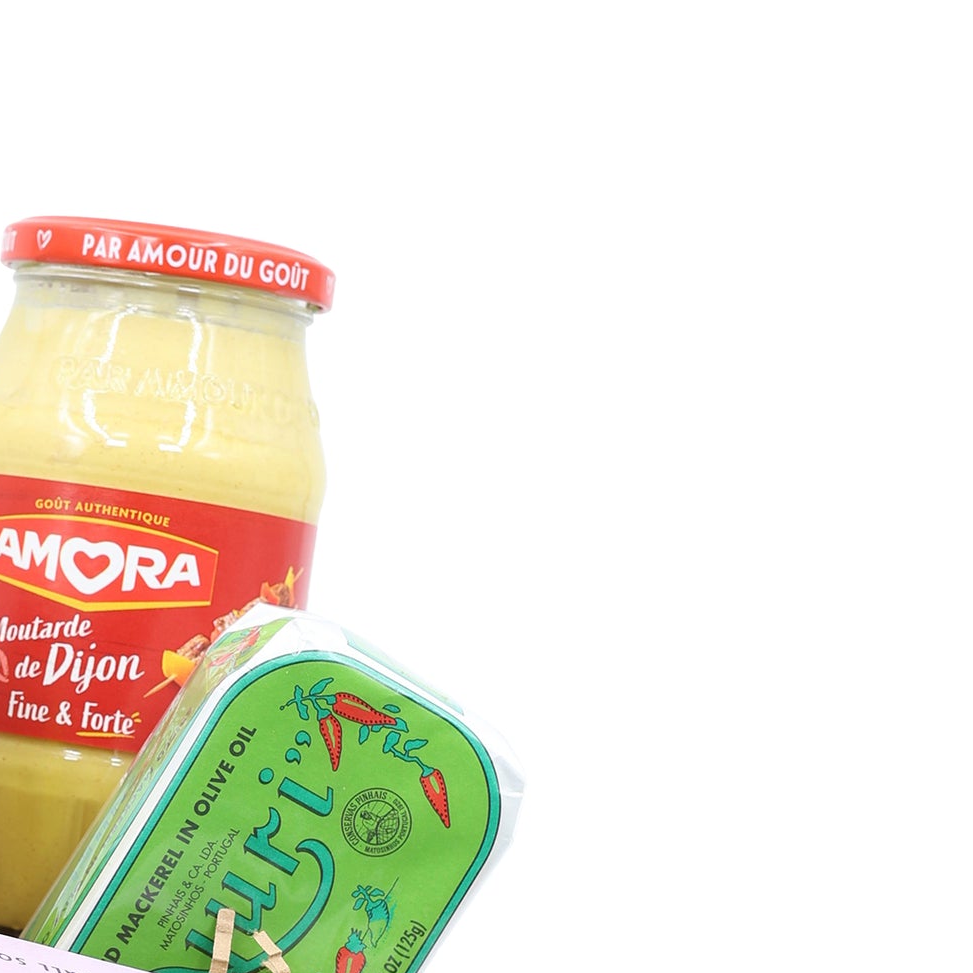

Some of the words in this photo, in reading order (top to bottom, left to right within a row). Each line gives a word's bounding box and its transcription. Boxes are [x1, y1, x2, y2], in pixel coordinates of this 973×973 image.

[81, 233, 122, 262] PAR
[126, 244, 218, 274] AMOUR
[223, 252, 255, 279] DU
[258, 260, 310, 292] GOÛT
[35, 496, 72, 511] GOÛT
[74, 501, 171, 528] AUTHENTIQUE
[14, 656, 42, 680] de
[42, 642, 144, 694] Dijon
[7, 691, 51, 722] Fine
[55, 703, 73, 726] &
[81, 702, 136, 735] Forte
[116, 848, 184, 946] MACKEREL
[176, 818, 200, 846] IN
[194, 759, 236, 817] OLIVE
[228, 726, 258, 757] OIL
[344, 802, 359, 846] CONSERVAS
[355, 791, 387, 805] PINHAIS
[157, 888, 185, 929] PINHAIS
[183, 878, 193, 891] &
[188, 862, 203, 879] CA.
[199, 839, 219, 862] LDA.
[160, 885, 205, 952] MATOSINHOS
[205, 828, 240, 879] PORTUGAL
[384, 955, 402, 973] OZ
[393, 920, 427, 959] (125g)
